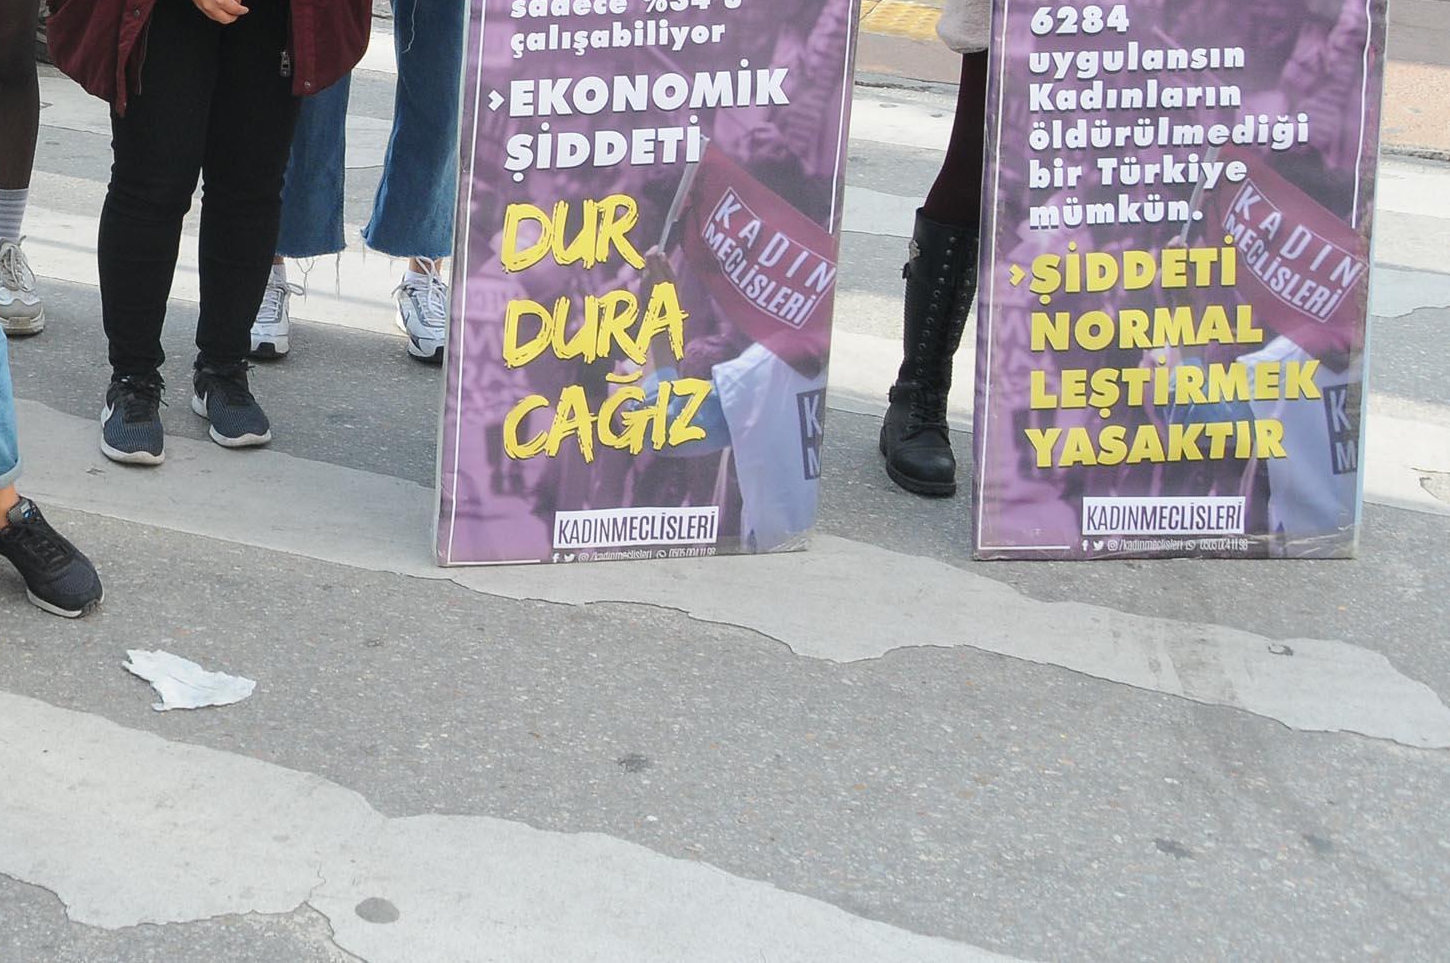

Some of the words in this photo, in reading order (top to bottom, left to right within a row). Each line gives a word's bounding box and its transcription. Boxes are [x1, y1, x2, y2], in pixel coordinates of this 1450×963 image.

[510, 19, 726, 58] çalışabiliyor
[1030, 4, 1130, 36] 6284
[1028, 42, 1245, 79] uygulansın
[509, 58, 790, 117] EKONOMİK
[1028, 79, 1241, 112] Kadınların
[504, 114, 701, 183] ŞİDDETİ
[1028, 112, 1309, 152] öldürülmediği
[1028, 158, 1082, 189] bir
[1097, 153, 1248, 189] Türkiye
[501, 193, 647, 274] DUR
[1028, 195, 1203, 230] mümkün.
[1235, 186, 1364, 287] KADIN
[715, 194, 837, 293] KADIN
[1029, 234, 1237, 305] ŞİDDETİ
[1226, 214, 1343, 318] MECLİSLERİ
[705, 223, 817, 325] MECLİSLERİ
[503, 281, 689, 369] DURA
[1030, 304, 1263, 352] NORMAL
[1030, 355, 1322, 418] LEŞTİRMEK
[503, 371, 712, 463] CAĞIZ
[1024, 420, 1288, 468] YASAKTIR
[558, 511, 716, 545] KADINMECLİSLERİ
[1087, 501, 1243, 531] KADINMECLİSLERİ
